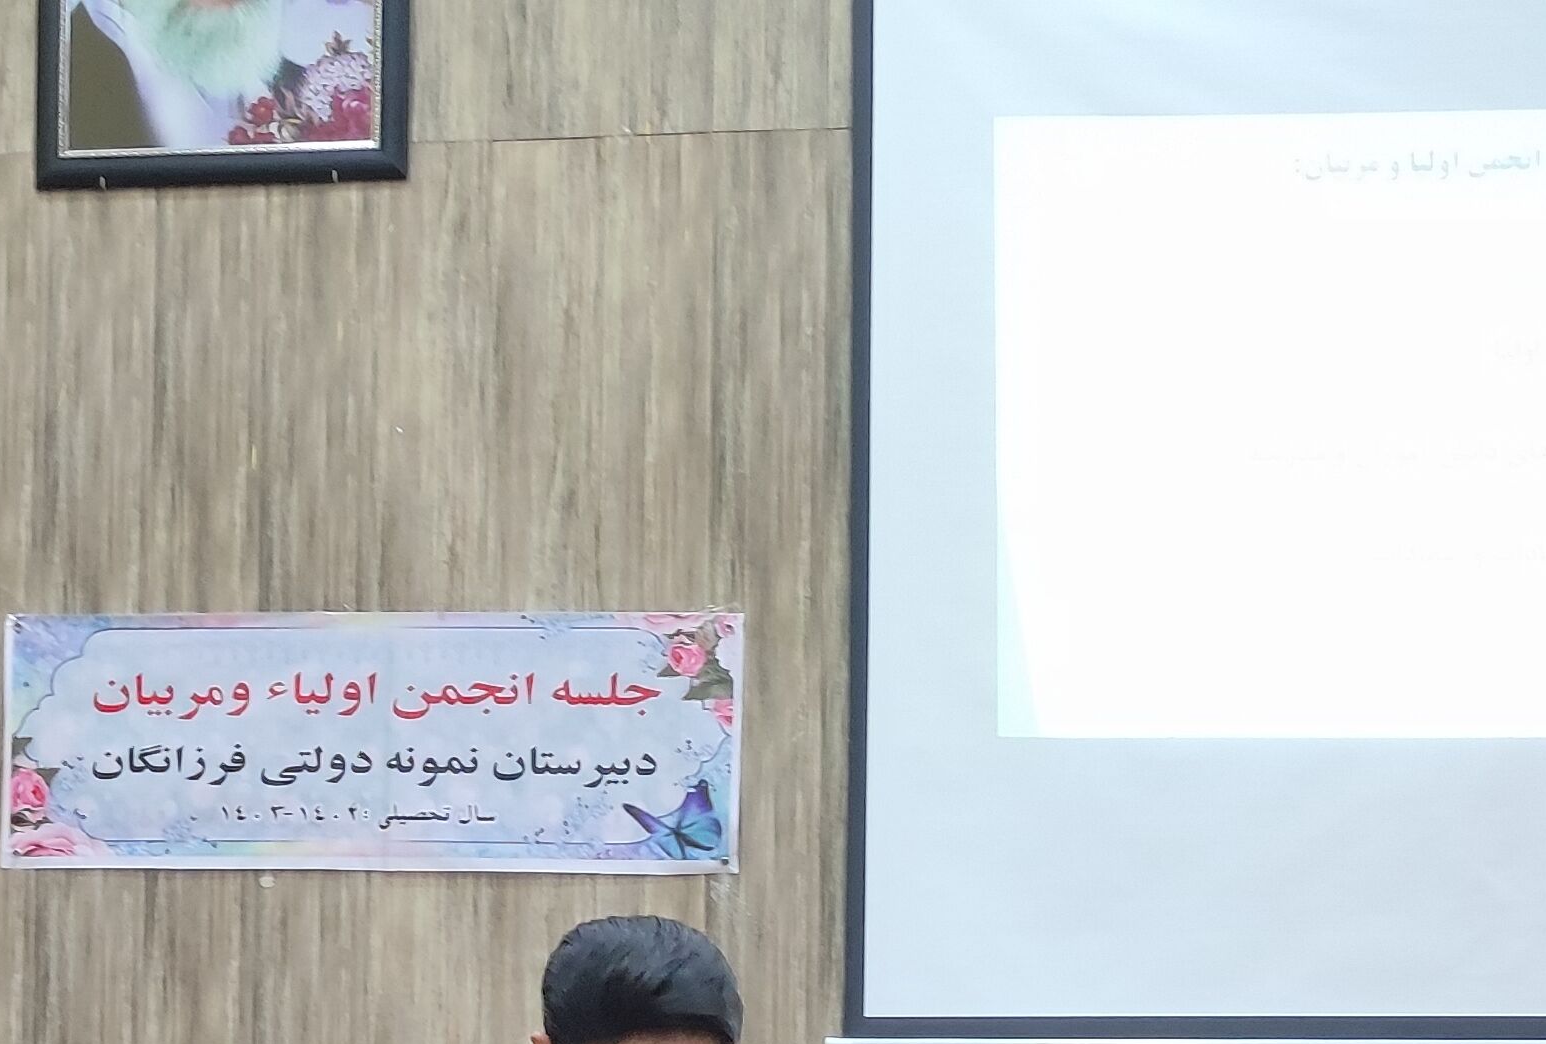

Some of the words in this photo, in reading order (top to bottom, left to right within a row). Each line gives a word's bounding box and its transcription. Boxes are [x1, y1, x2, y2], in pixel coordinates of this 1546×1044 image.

[266, 671, 376, 722] اولیاء
[392, 674, 533, 720] انجمن
[551, 672, 662, 722] جلسه
[91, 742, 248, 785] فرزانگان
[260, 745, 373, 788] دولتی
[386, 748, 479, 784] نمونه
[492, 745, 657, 787] دبیرستان
[458, 804, 496, 824] سال
